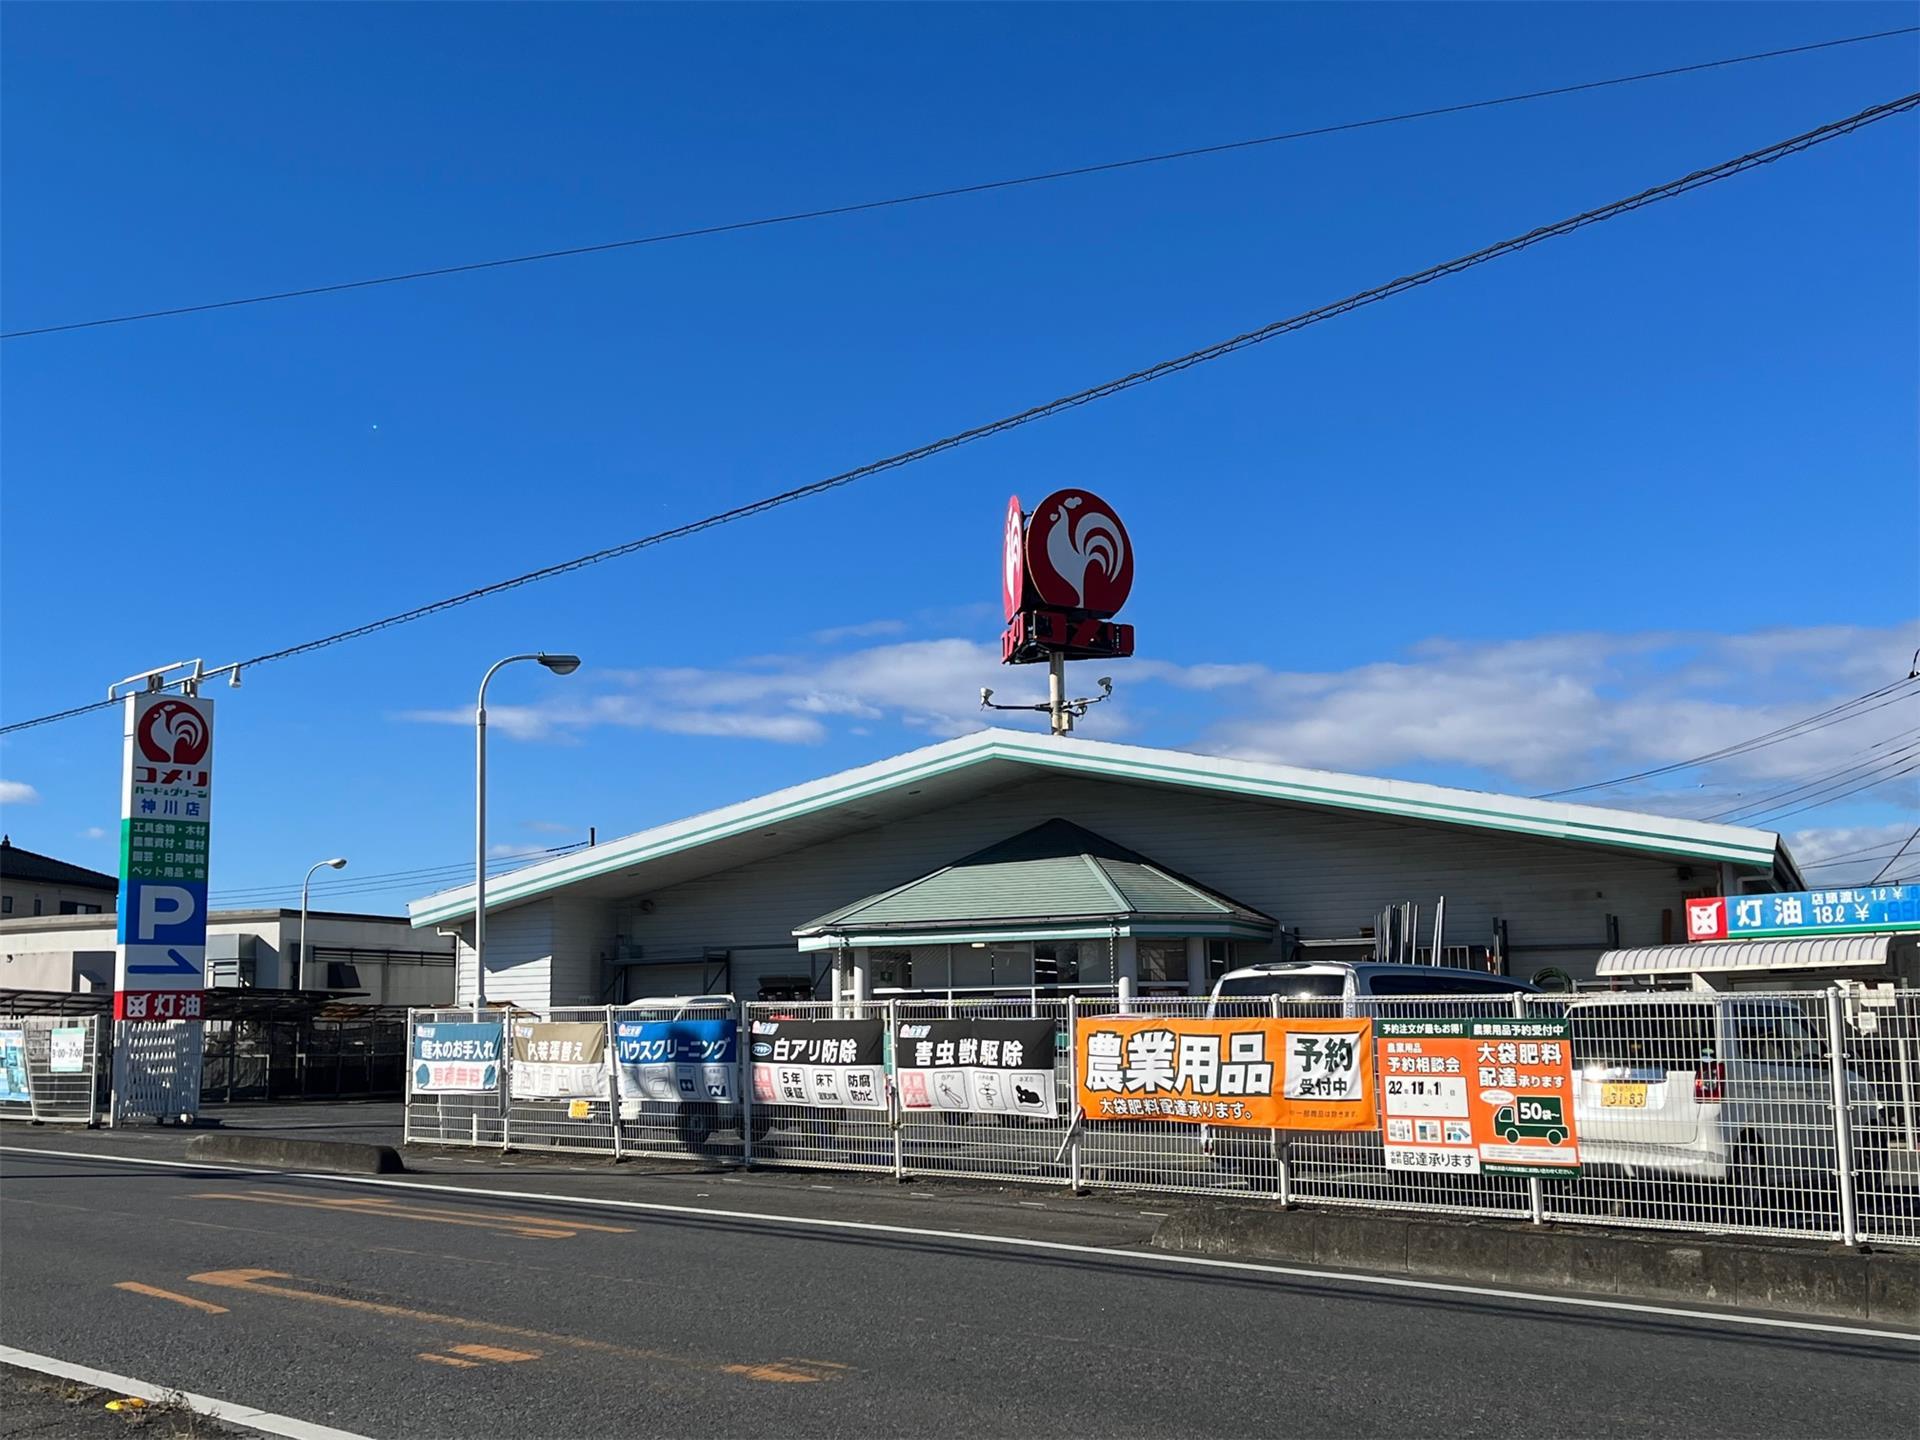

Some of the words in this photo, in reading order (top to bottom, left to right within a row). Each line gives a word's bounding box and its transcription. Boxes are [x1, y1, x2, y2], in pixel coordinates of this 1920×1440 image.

[136, 766, 208, 787] コメリ
[141, 798, 200, 817] 神川店
[138, 885, 195, 940] P
[1736, 898, 1802, 927] 灯油
[154, 994, 201, 1017] 灯油
[1473, 1023, 1564, 1036] 農業用品予約受付中
[421, 1039, 495, 1060] 庭木のお手入れ
[527, 1040, 583, 1062] 内装張替え
[619, 1037, 732, 1060] ハウスクリーニング
[773, 1038, 858, 1064] 白アリ防除
[915, 1038, 1024, 1067] 害虫獣駆除
[1294, 1037, 1353, 1072] 予約
[1477, 1042, 1562, 1065] 大袋肥料
[1084, 1028, 1274, 1097] 農業用品
[1387, 1056, 1460, 1073] 予約相談会
[782, 1072, 802, 1085] 5年
[816, 1073, 833, 1087] 床下
[847, 1074, 871, 1088] 防腐
[1299, 1077, 1347, 1096] 受付中
[1098, 1097, 1252, 1119] 大袋肥料配達承ります。
[1403, 1151, 1474, 1168] 配達承ります
